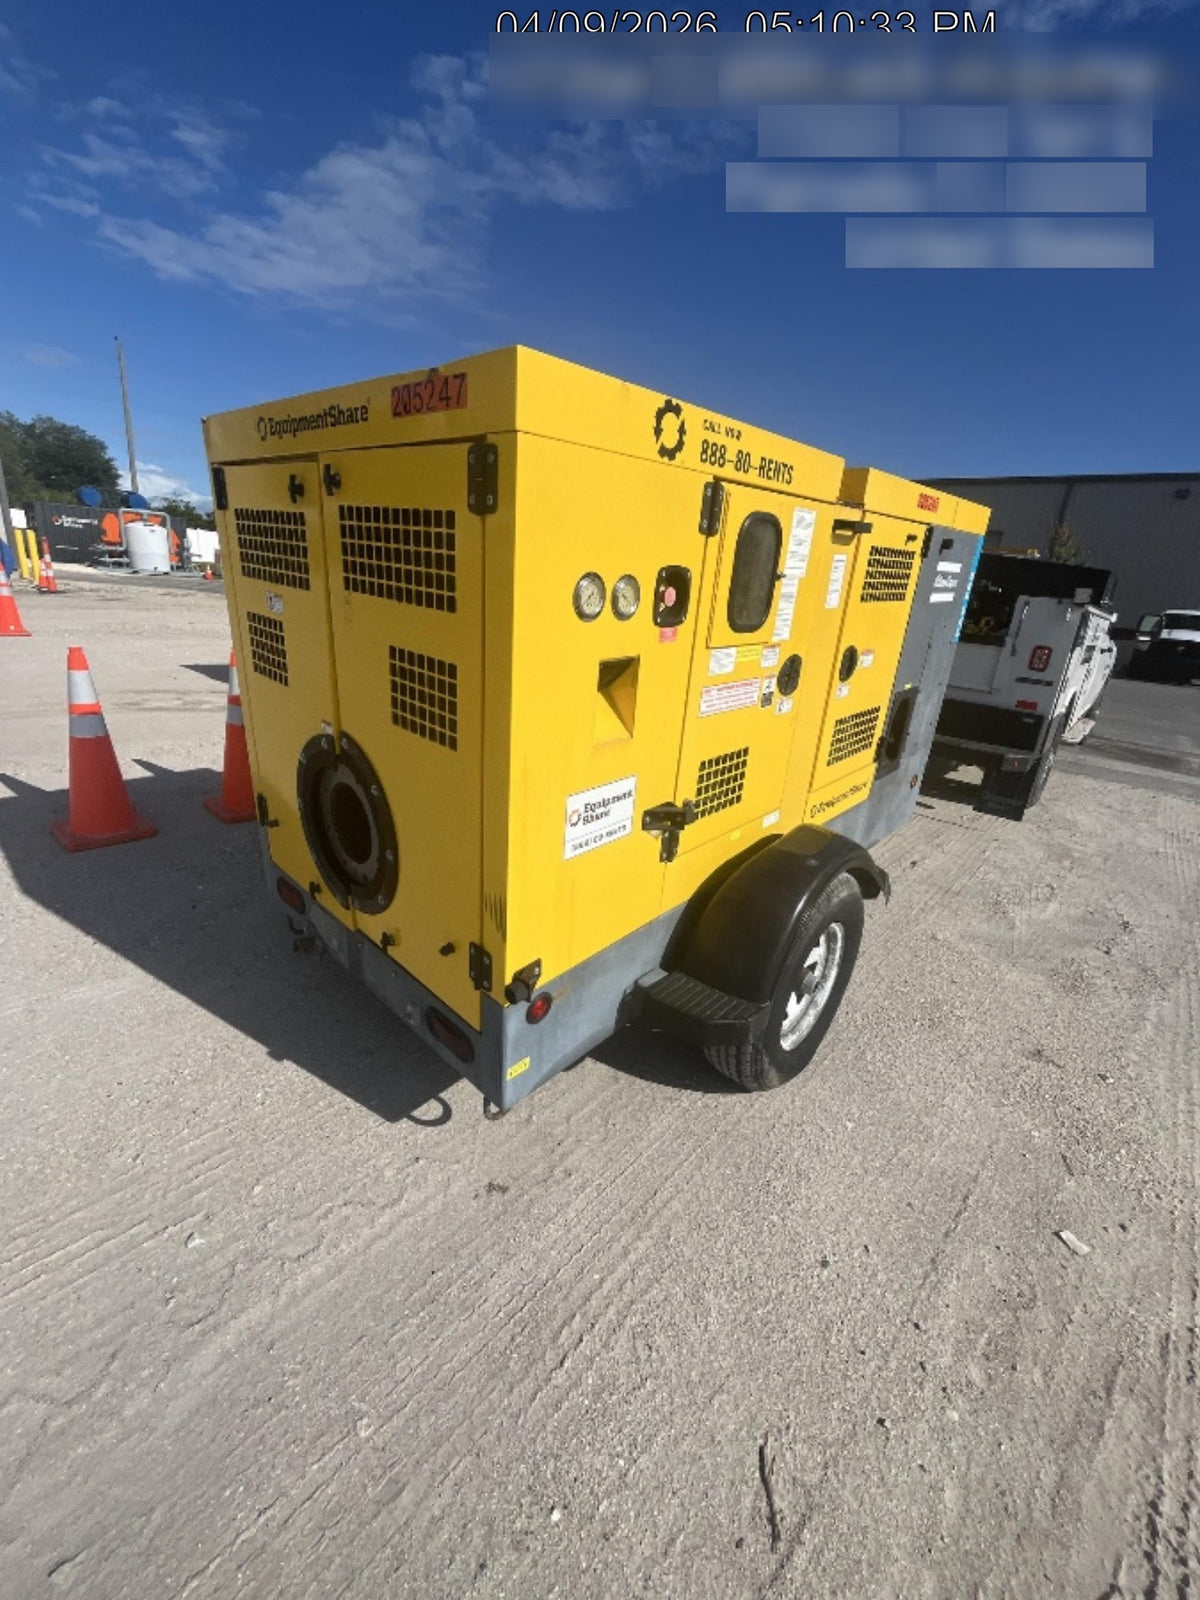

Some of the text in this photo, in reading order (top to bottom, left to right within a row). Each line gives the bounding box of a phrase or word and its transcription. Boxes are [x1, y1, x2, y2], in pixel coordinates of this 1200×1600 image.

[392, 373, 467, 416] 205247
[268, 403, 370, 439] EquipmentShare
[700, 438, 793, 484] 888-80-RENTS
